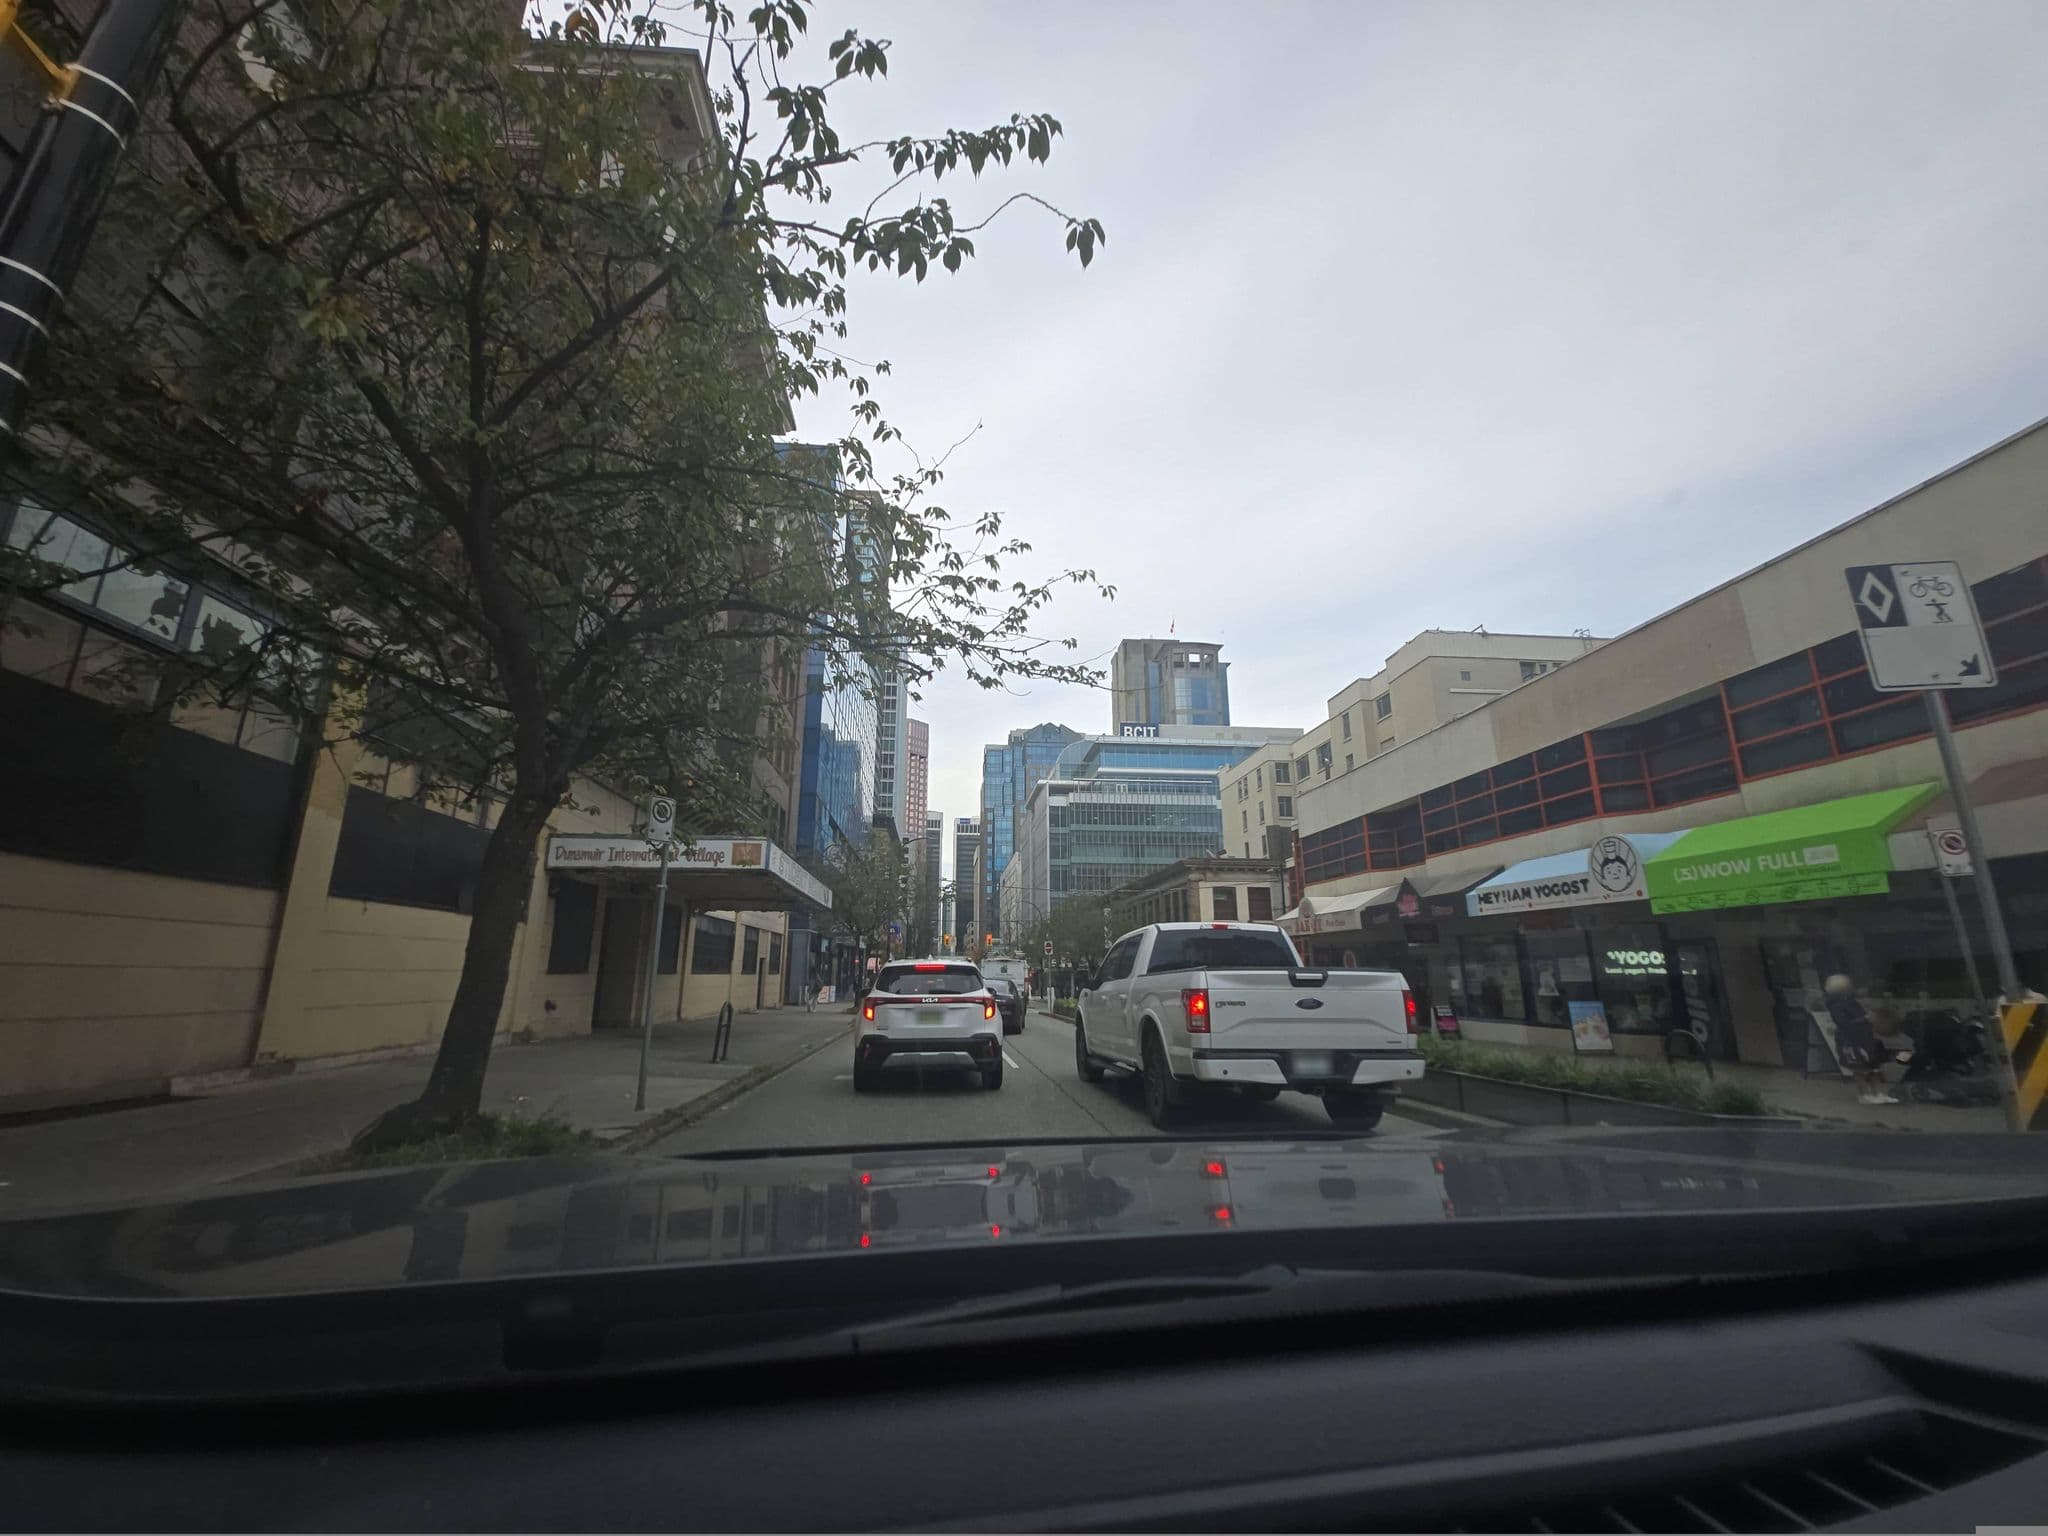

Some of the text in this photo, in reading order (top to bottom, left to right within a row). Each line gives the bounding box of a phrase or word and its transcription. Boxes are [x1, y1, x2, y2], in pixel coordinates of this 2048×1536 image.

[1124, 726, 1156, 737] BCIT
[1698, 857, 1752, 880] WOW
[1757, 850, 1805, 873] FULL
[1534, 878, 1591, 899] YOGOST
